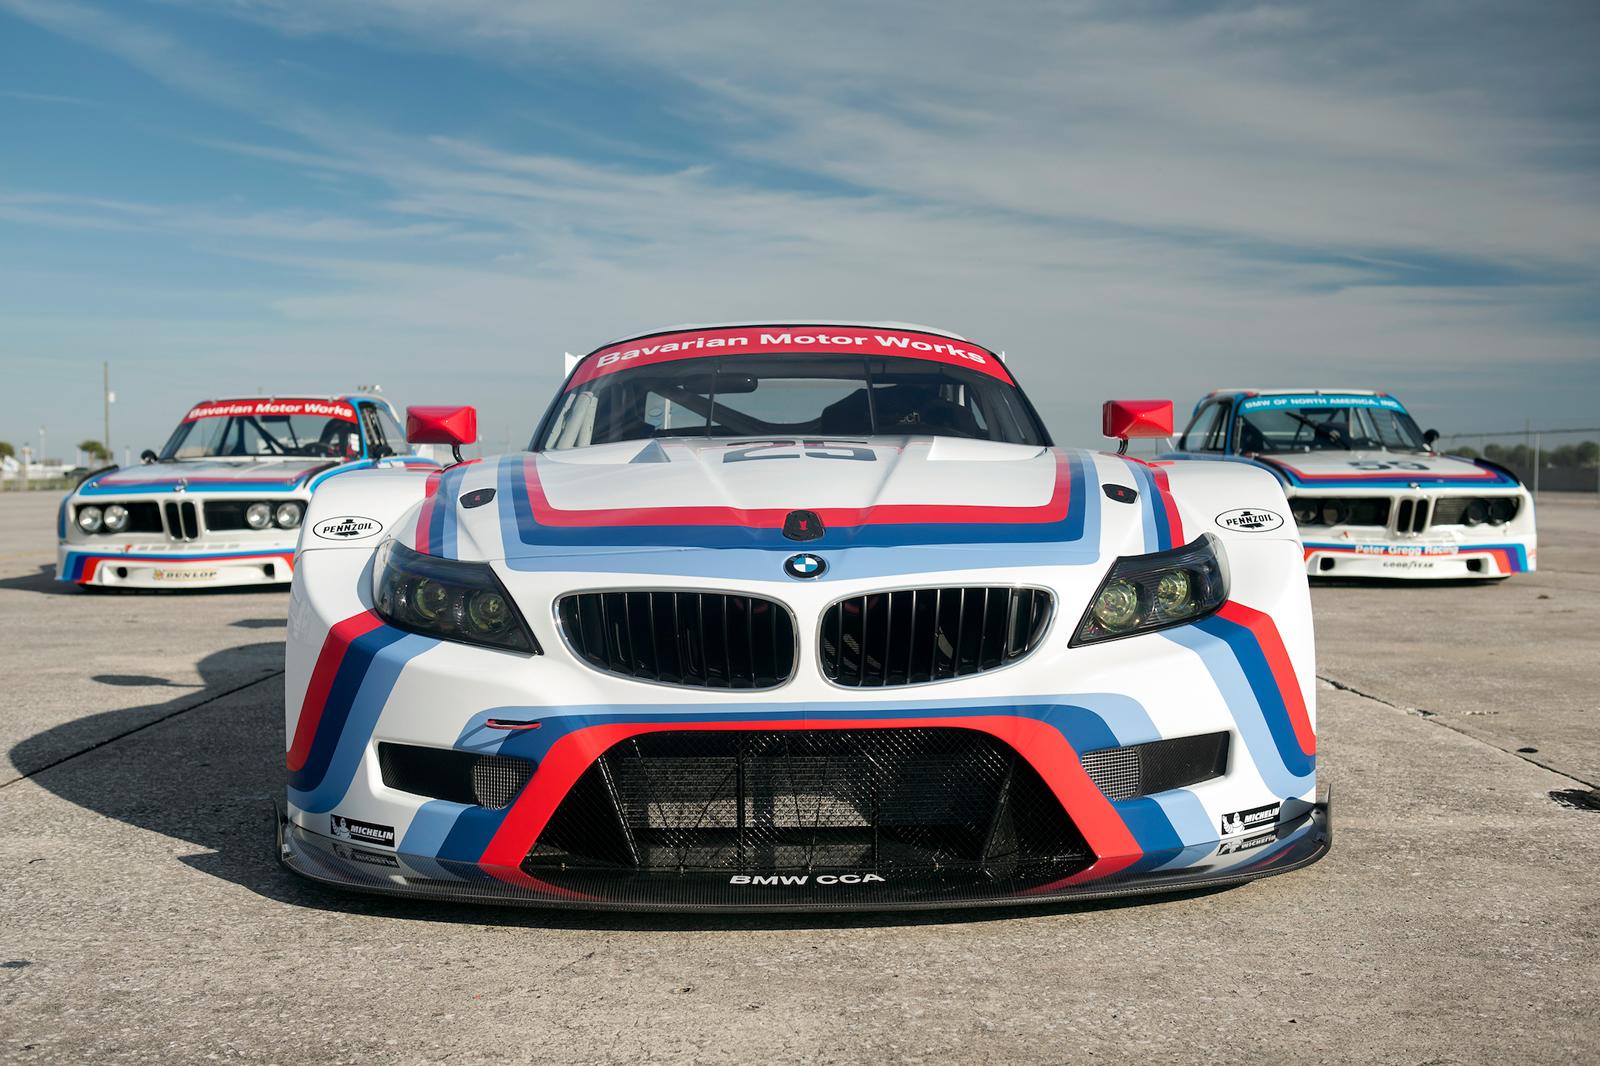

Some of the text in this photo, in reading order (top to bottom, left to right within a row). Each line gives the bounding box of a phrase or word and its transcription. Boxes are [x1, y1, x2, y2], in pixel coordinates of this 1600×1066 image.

[596, 333, 986, 369] Bavarian Motor Works
[189, 403, 353, 419] Bavarian Motor Works
[1245, 400, 1270, 409] BMW
[722, 440, 877, 463] 25
[1225, 514, 1274, 526] PENNZOIL
[323, 522, 373, 534] PENNZOIL
[1355, 545, 1386, 554] Peter
[1388, 546, 1422, 557] Gregg
[1244, 807, 1280, 824] MICHELIN
[351, 825, 394, 840] MICHELIN
[729, 873, 886, 885] BMW CCA
